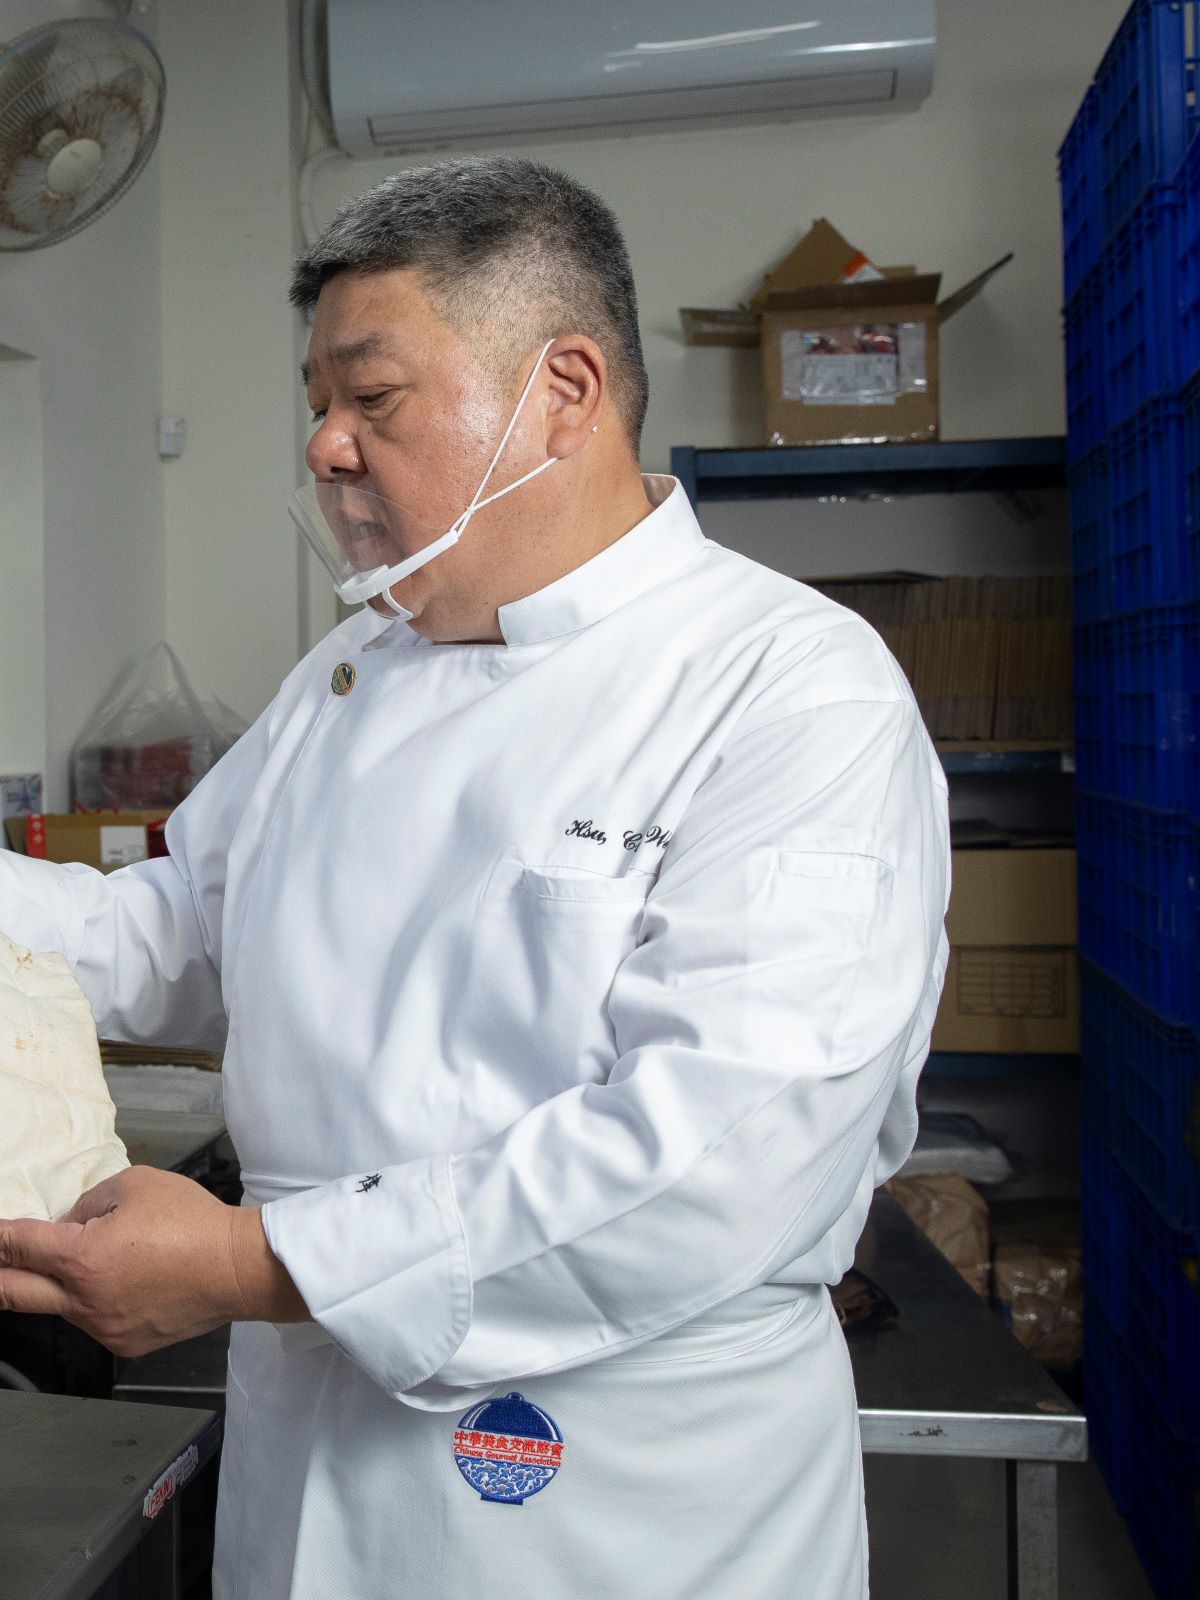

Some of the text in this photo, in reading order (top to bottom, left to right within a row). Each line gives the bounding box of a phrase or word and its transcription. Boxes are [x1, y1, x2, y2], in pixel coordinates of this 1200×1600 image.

[454, 1446, 561, 1468] Chinese Gourmet Association
